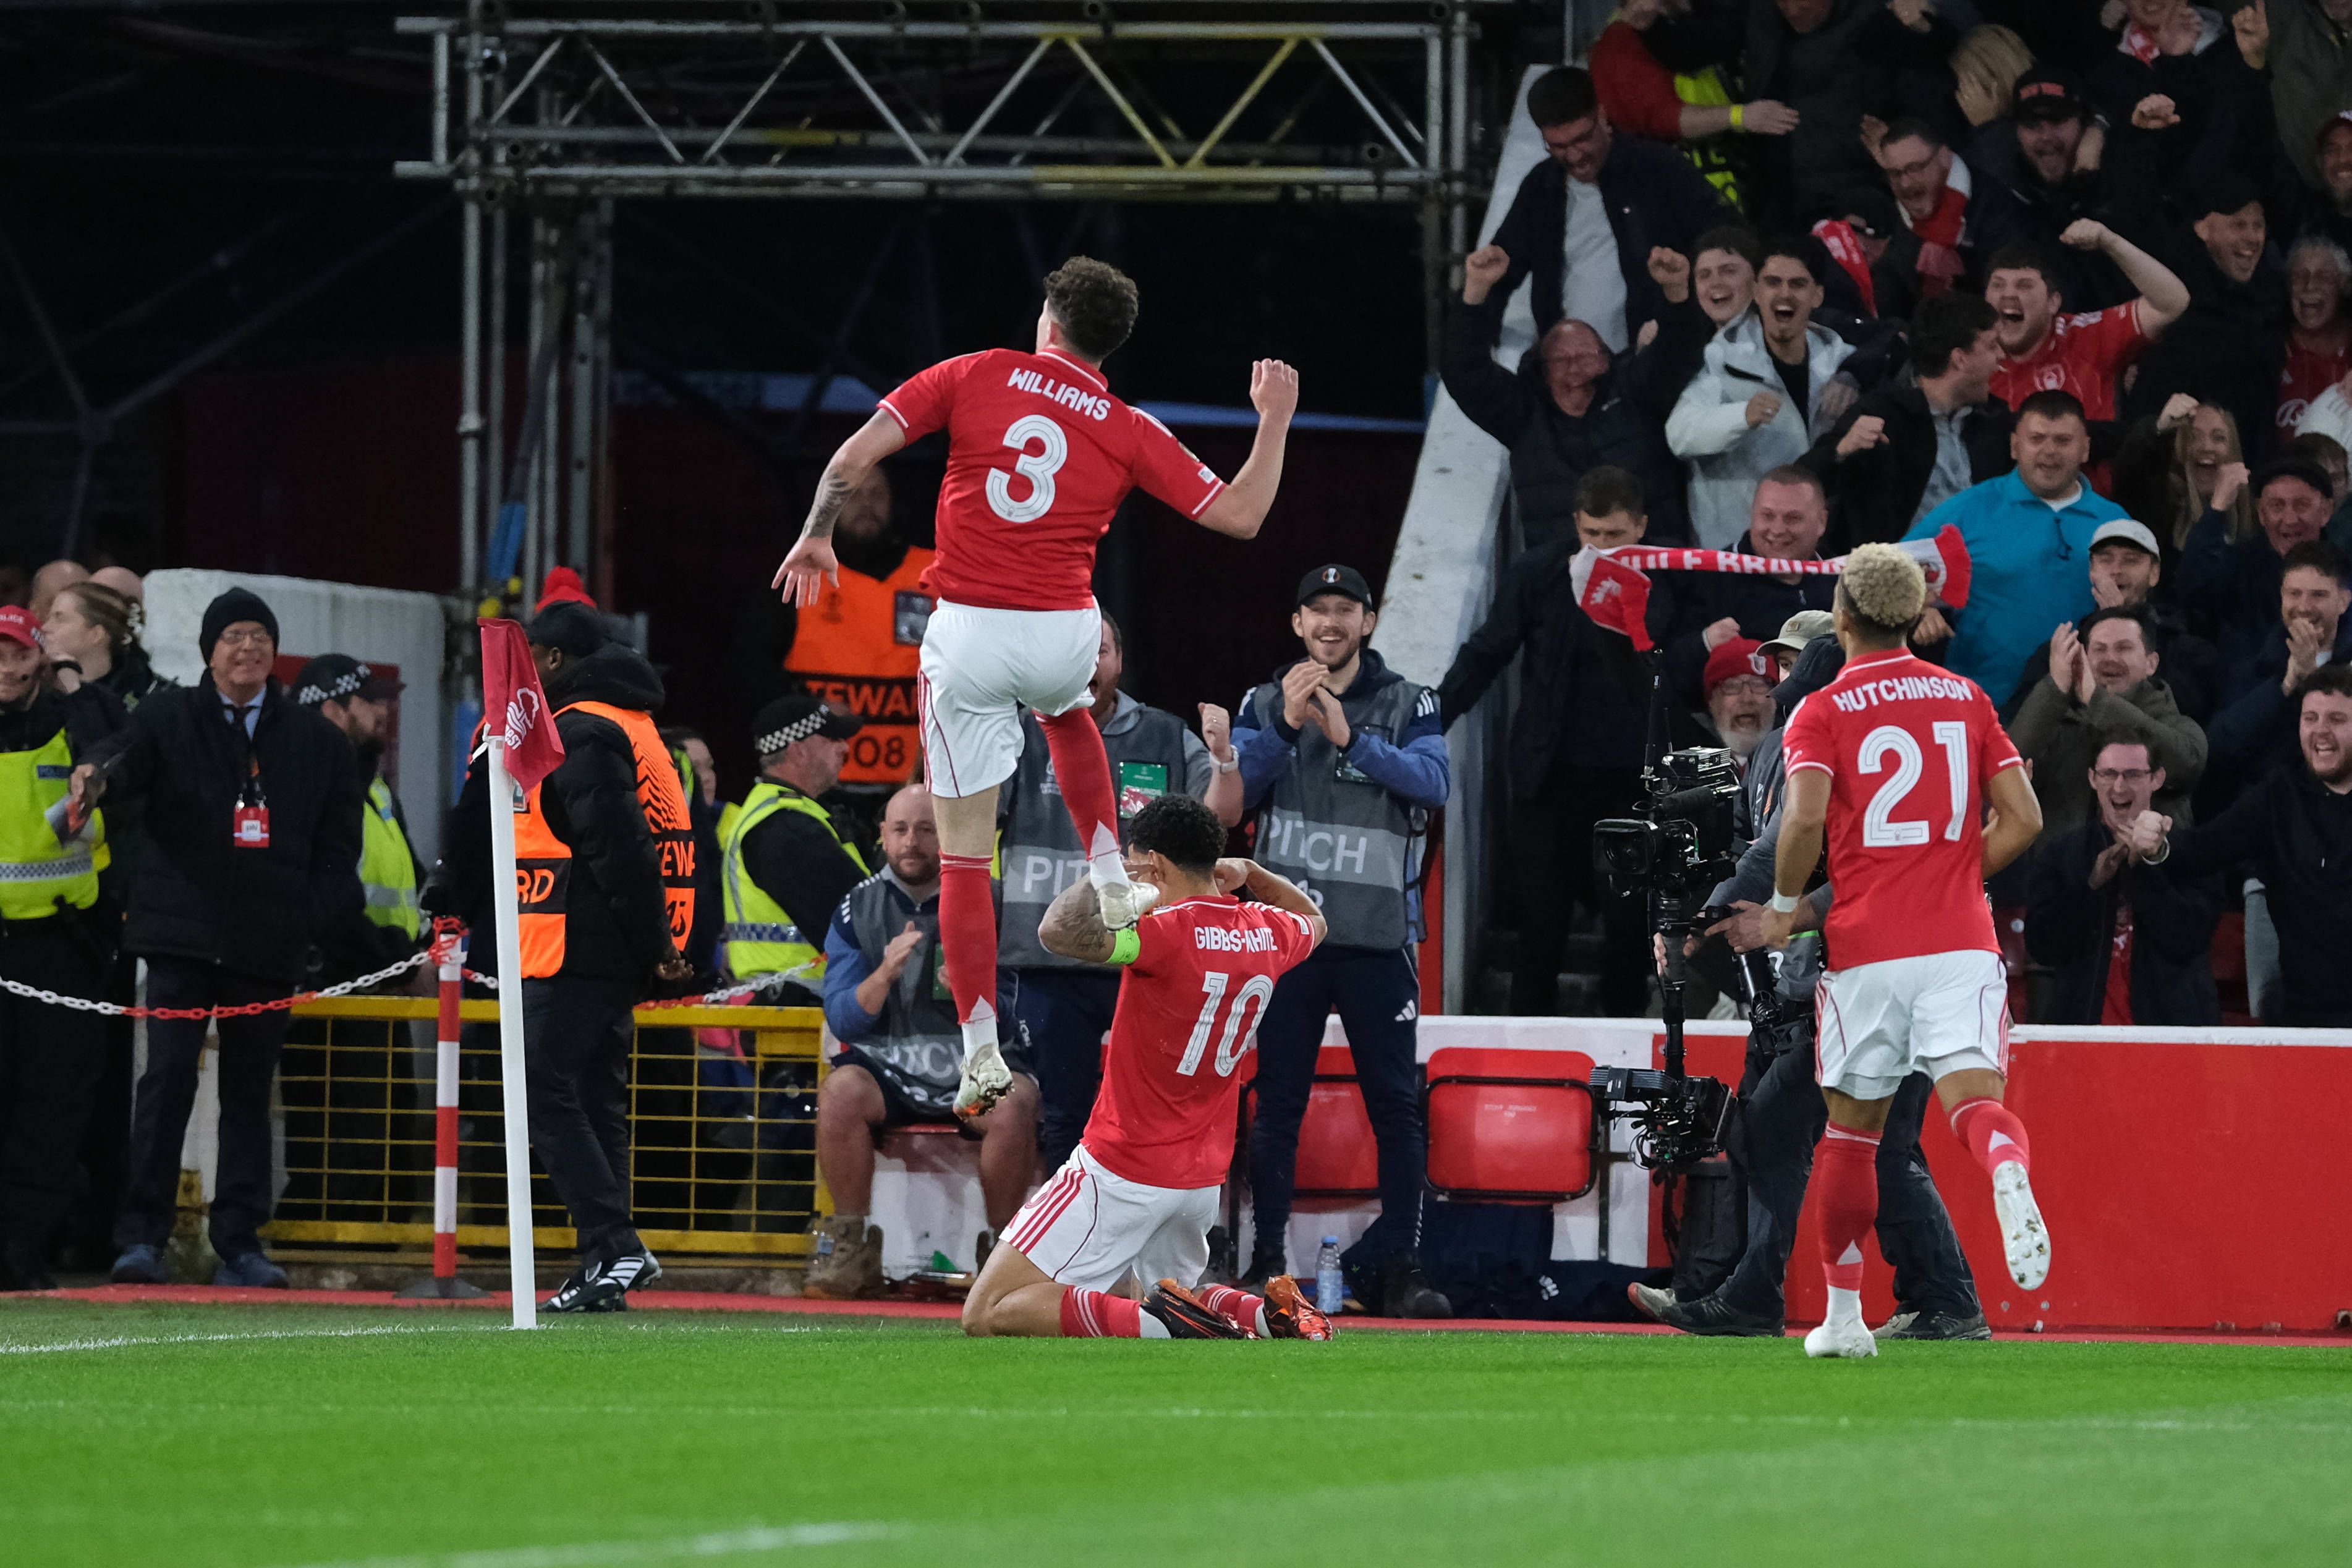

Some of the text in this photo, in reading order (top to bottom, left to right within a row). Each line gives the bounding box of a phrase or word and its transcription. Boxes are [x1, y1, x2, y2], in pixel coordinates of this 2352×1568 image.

[1007, 368, 1111, 421] WILLIAMS
[985, 414, 1068, 523] 3
[1832, 676, 1973, 713] HUTCHINSON
[842, 735, 906, 769] 08
[1857, 721, 1969, 847] 21
[1024, 855, 1091, 897] PIT
[1176, 970, 1274, 1078] 10
